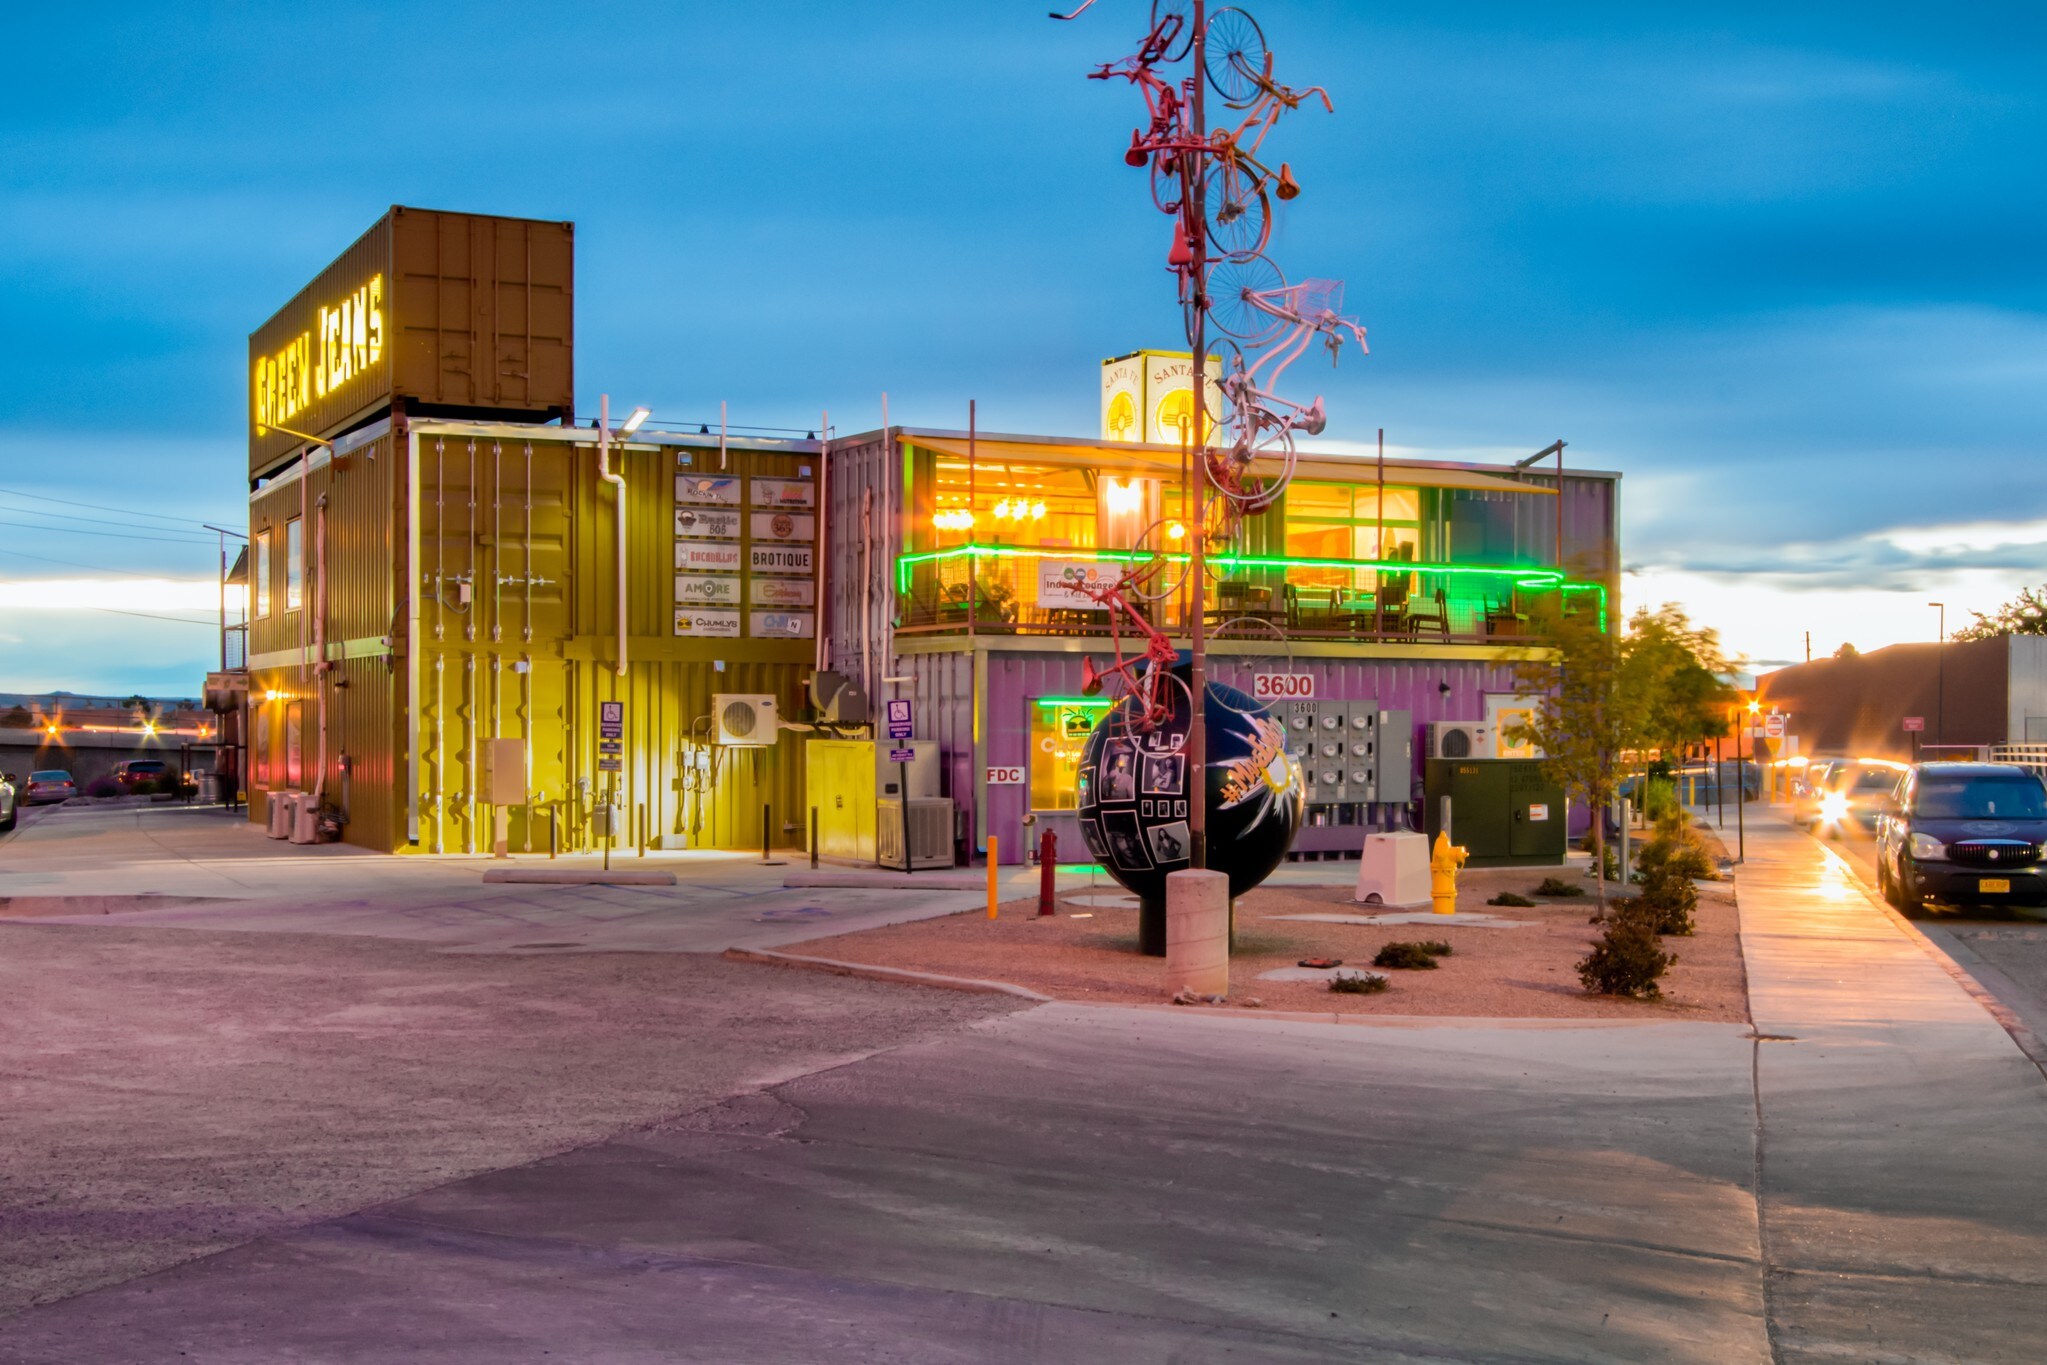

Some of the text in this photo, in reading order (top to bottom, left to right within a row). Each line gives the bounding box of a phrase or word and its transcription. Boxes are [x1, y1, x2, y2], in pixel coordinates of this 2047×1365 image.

[255, 273, 383, 437] GREEN JEANS
[1105, 367, 1128, 393] SANTA
[1154, 364, 1194, 384] SANTA
[753, 552, 809, 567] BROTIQUE
[685, 580, 730, 597] AMORE
[1256, 675, 1312, 696] 3600
[1294, 702, 1317, 713] 3600
[987, 769, 1020, 782] FDC
